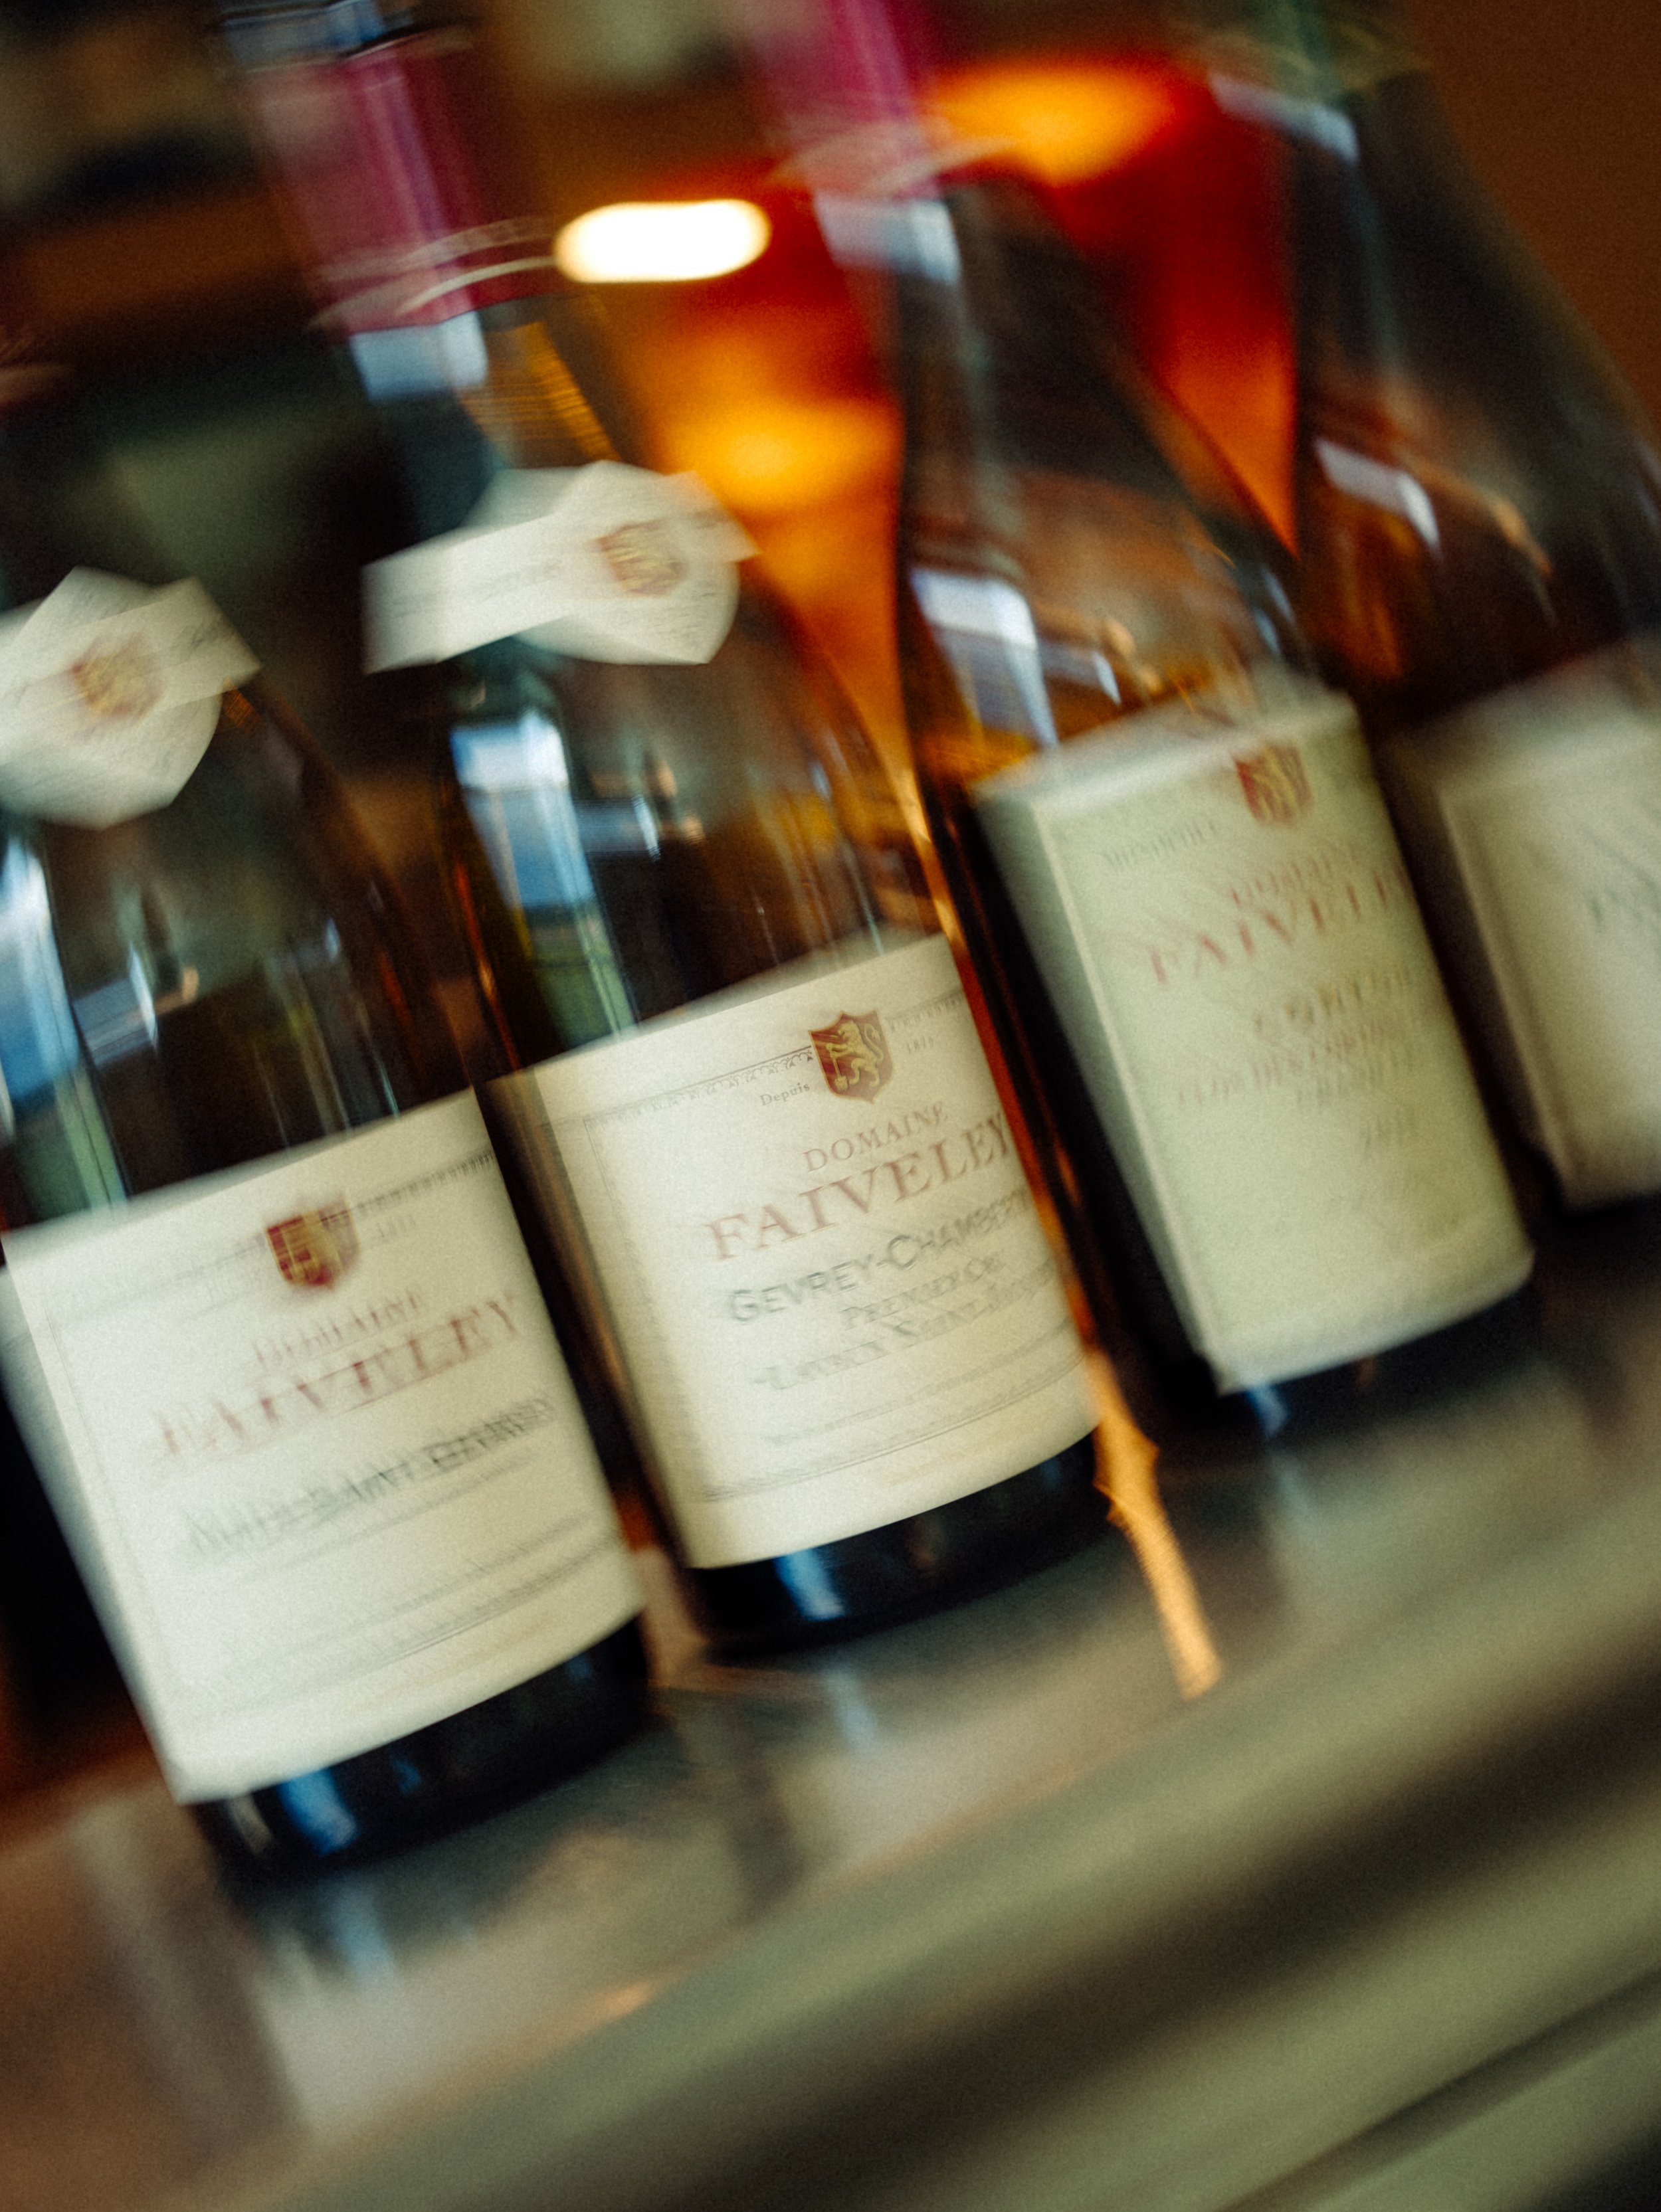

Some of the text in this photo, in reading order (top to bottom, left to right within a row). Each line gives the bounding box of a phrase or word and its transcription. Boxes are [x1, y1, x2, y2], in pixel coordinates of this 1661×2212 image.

[759, 1081, 811, 1107] Depuis
[802, 1099, 949, 1173] DOMAINE
[704, 1110, 1013, 1261] FAIVELEY
